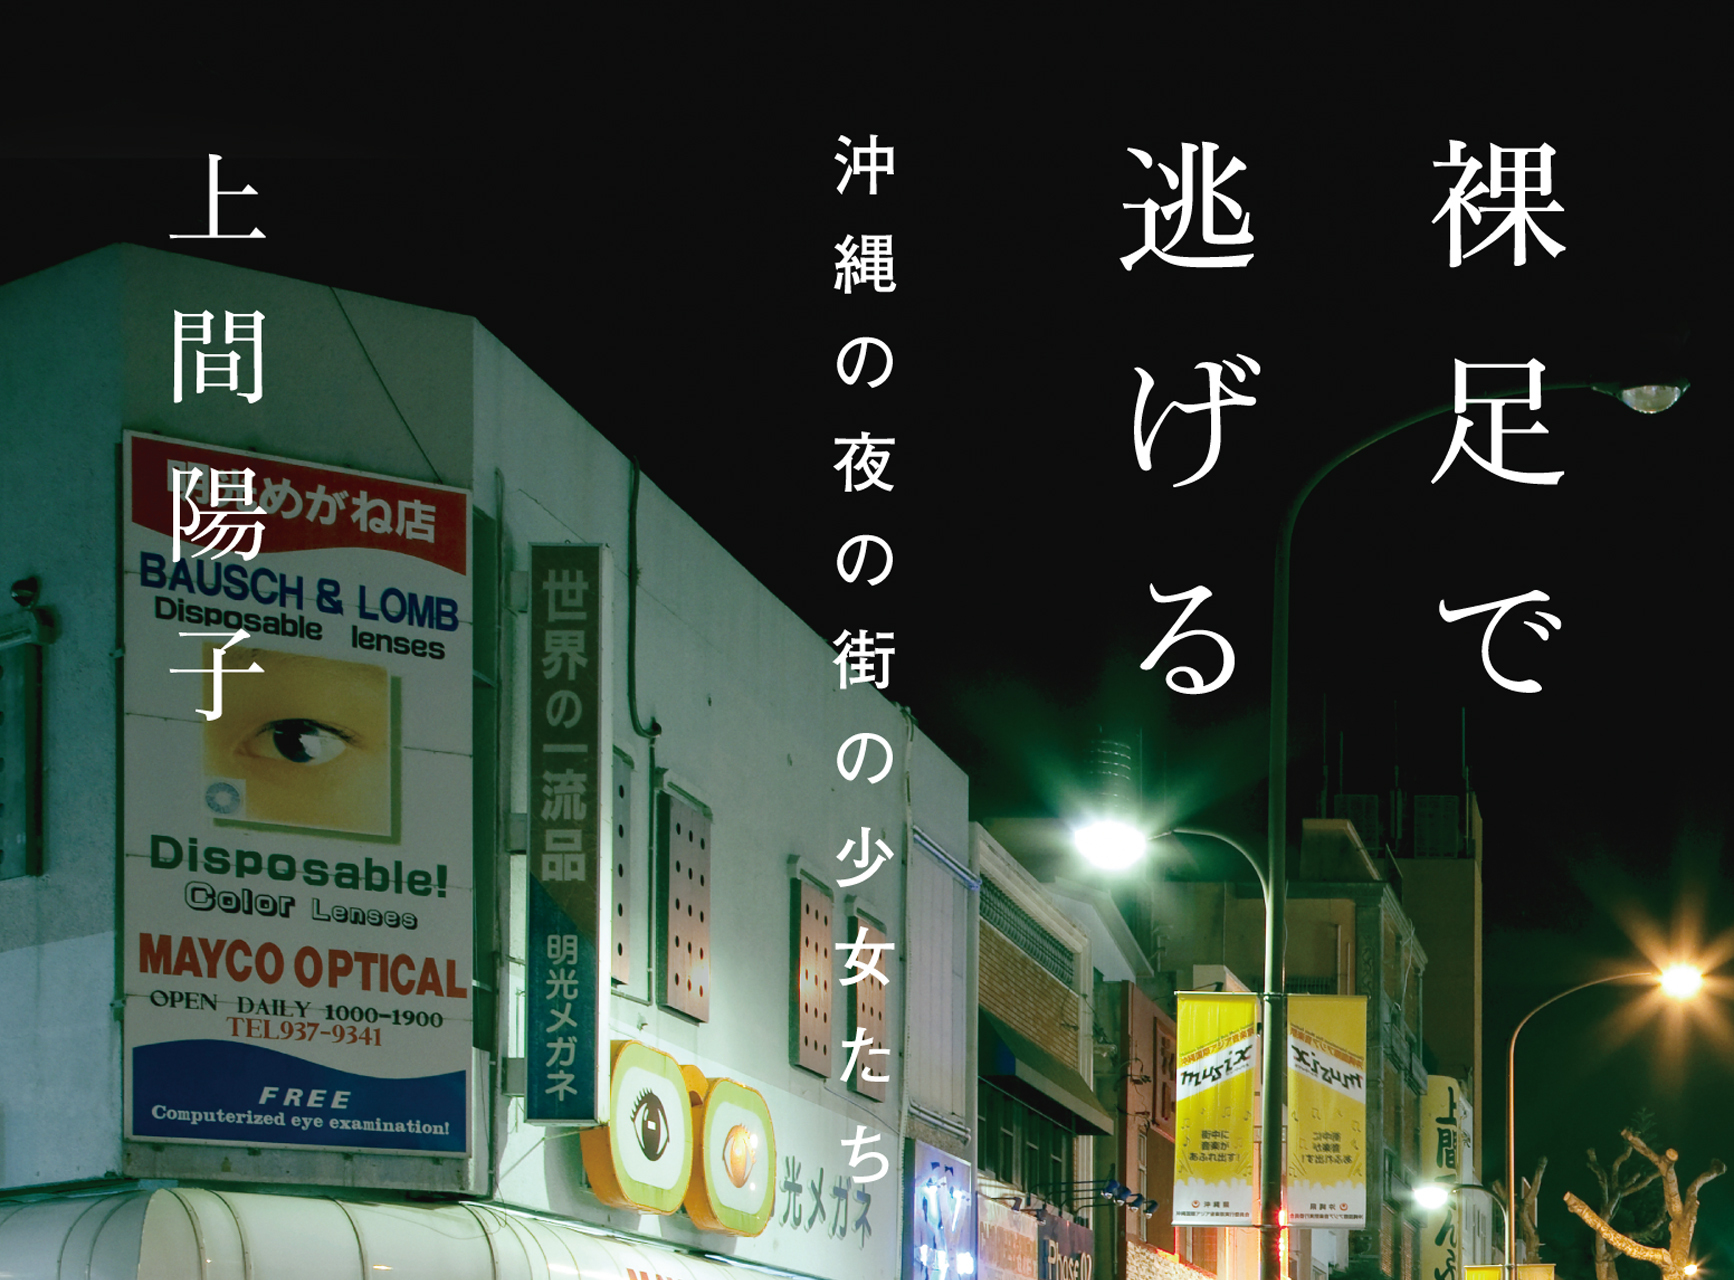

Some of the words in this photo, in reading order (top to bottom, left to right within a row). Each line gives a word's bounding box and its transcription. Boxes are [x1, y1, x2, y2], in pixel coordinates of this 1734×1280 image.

[140, 551, 303, 611] BAUSCH
[316, 578, 344, 616] &
[358, 585, 459, 632] LOMB
[154, 596, 323, 641] Disposable
[351, 625, 446, 660] lenses
[543, 569, 588, 882] 世界の一流品
[150, 834, 448, 898] Disposable!
[184, 881, 296, 918] Color
[311, 899, 418, 930] Lenses
[138, 932, 285, 985] MAYCO
[294, 945, 468, 999] OPTICAL
[150, 990, 218, 1011] OPEN
[237, 996, 312, 1018] DAILY
[324, 1003, 444, 1028] 1000-1900
[545, 934, 578, 1101] 明光メガネ
[258, 1086, 352, 1109] FREE
[1180, 1044, 1253, 1087] musix
[151, 1105, 286, 1126] Computerized
[291, 1113, 324, 1131] eye
[329, 1116, 450, 1136] examination!
